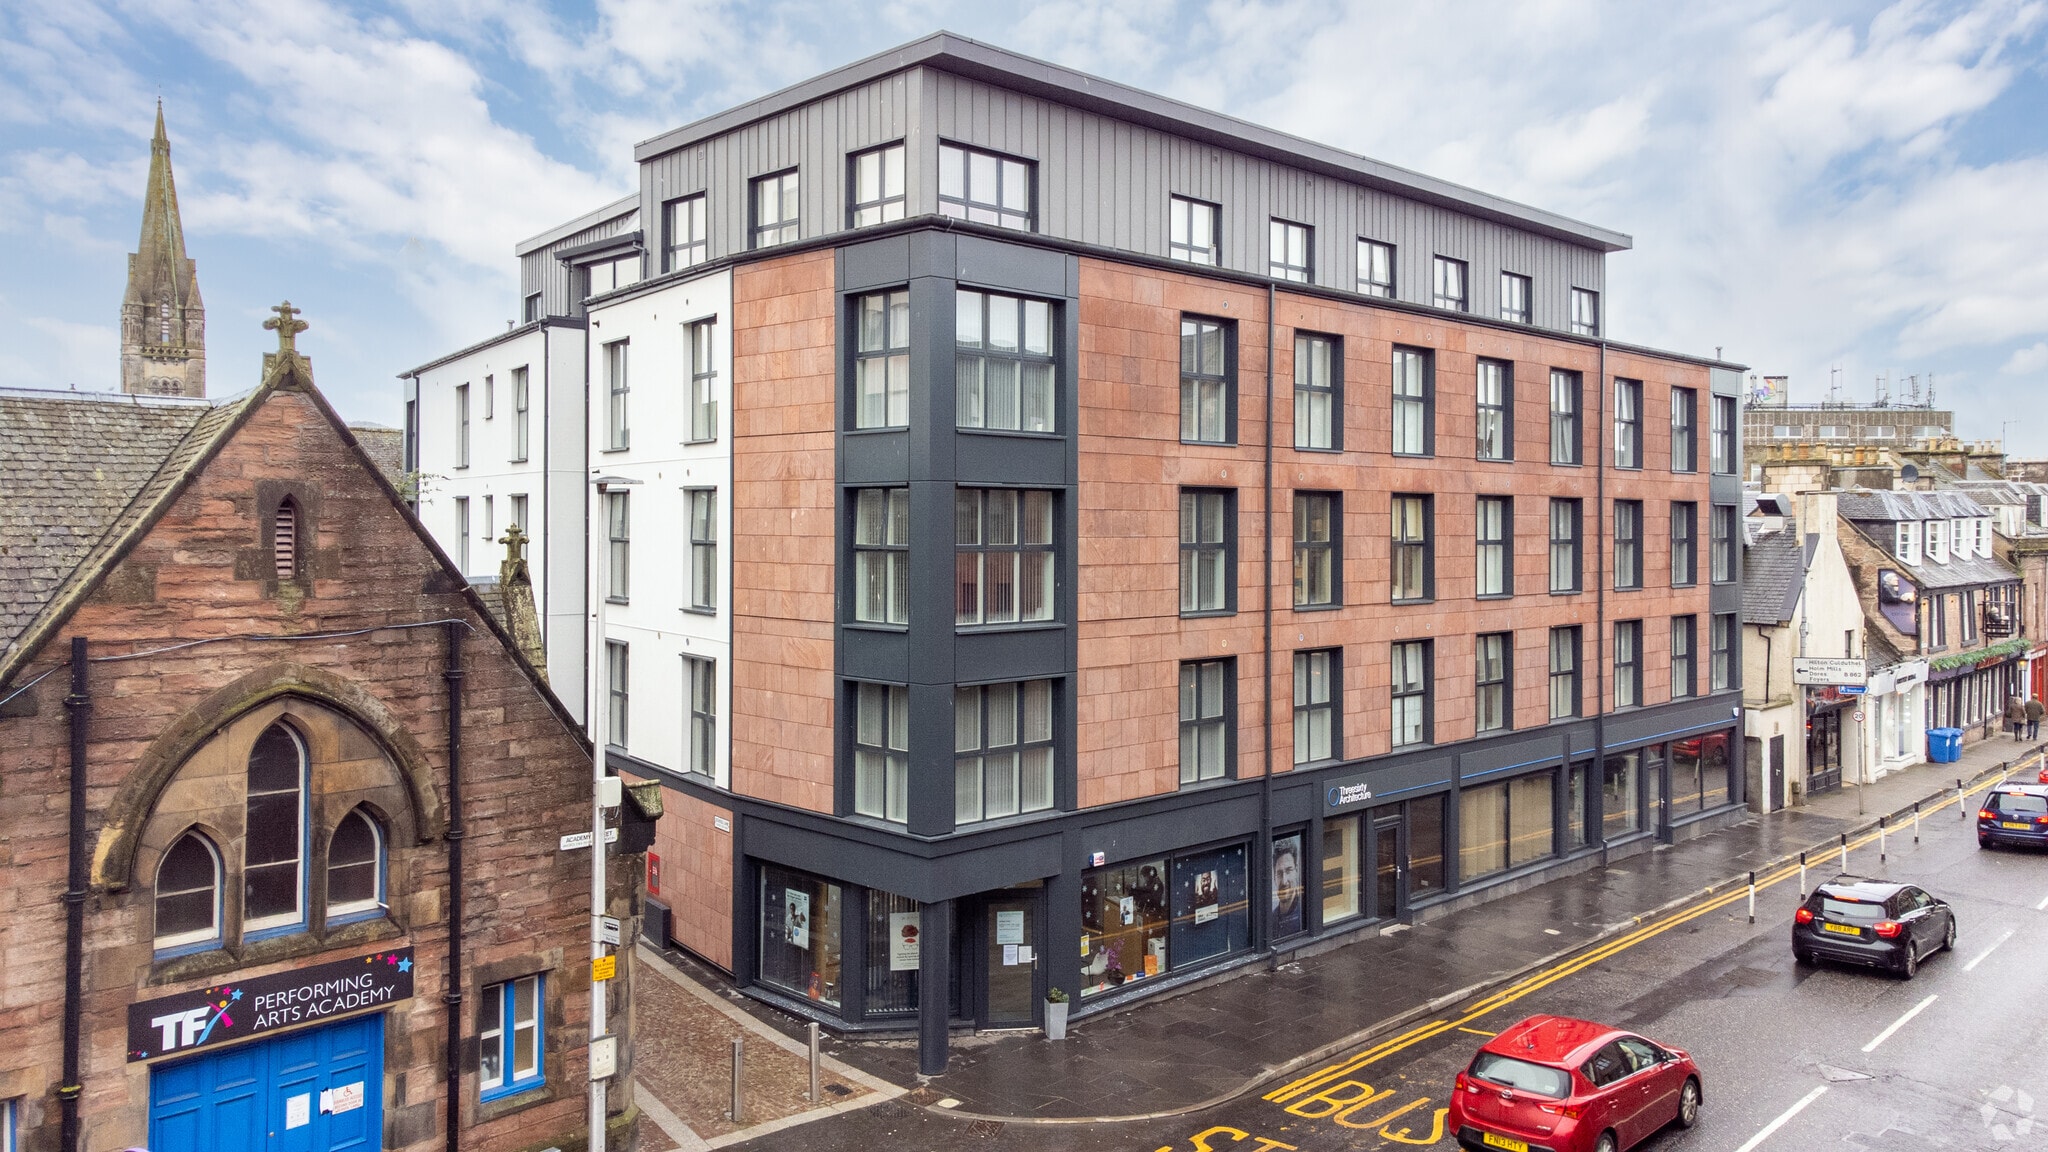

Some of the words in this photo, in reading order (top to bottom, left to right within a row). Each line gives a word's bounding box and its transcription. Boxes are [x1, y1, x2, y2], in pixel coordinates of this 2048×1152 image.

[1339, 791, 1372, 804] Architecture
[566, 834, 591, 843] ACADEMY
[254, 973, 373, 1012] PERFORMING
[253, 1005, 300, 1030] ARTS
[305, 984, 396, 1019] ACADEMY
[1284, 1080, 1449, 1145] BUS
[1507, 1140, 1523, 1151] HTY
